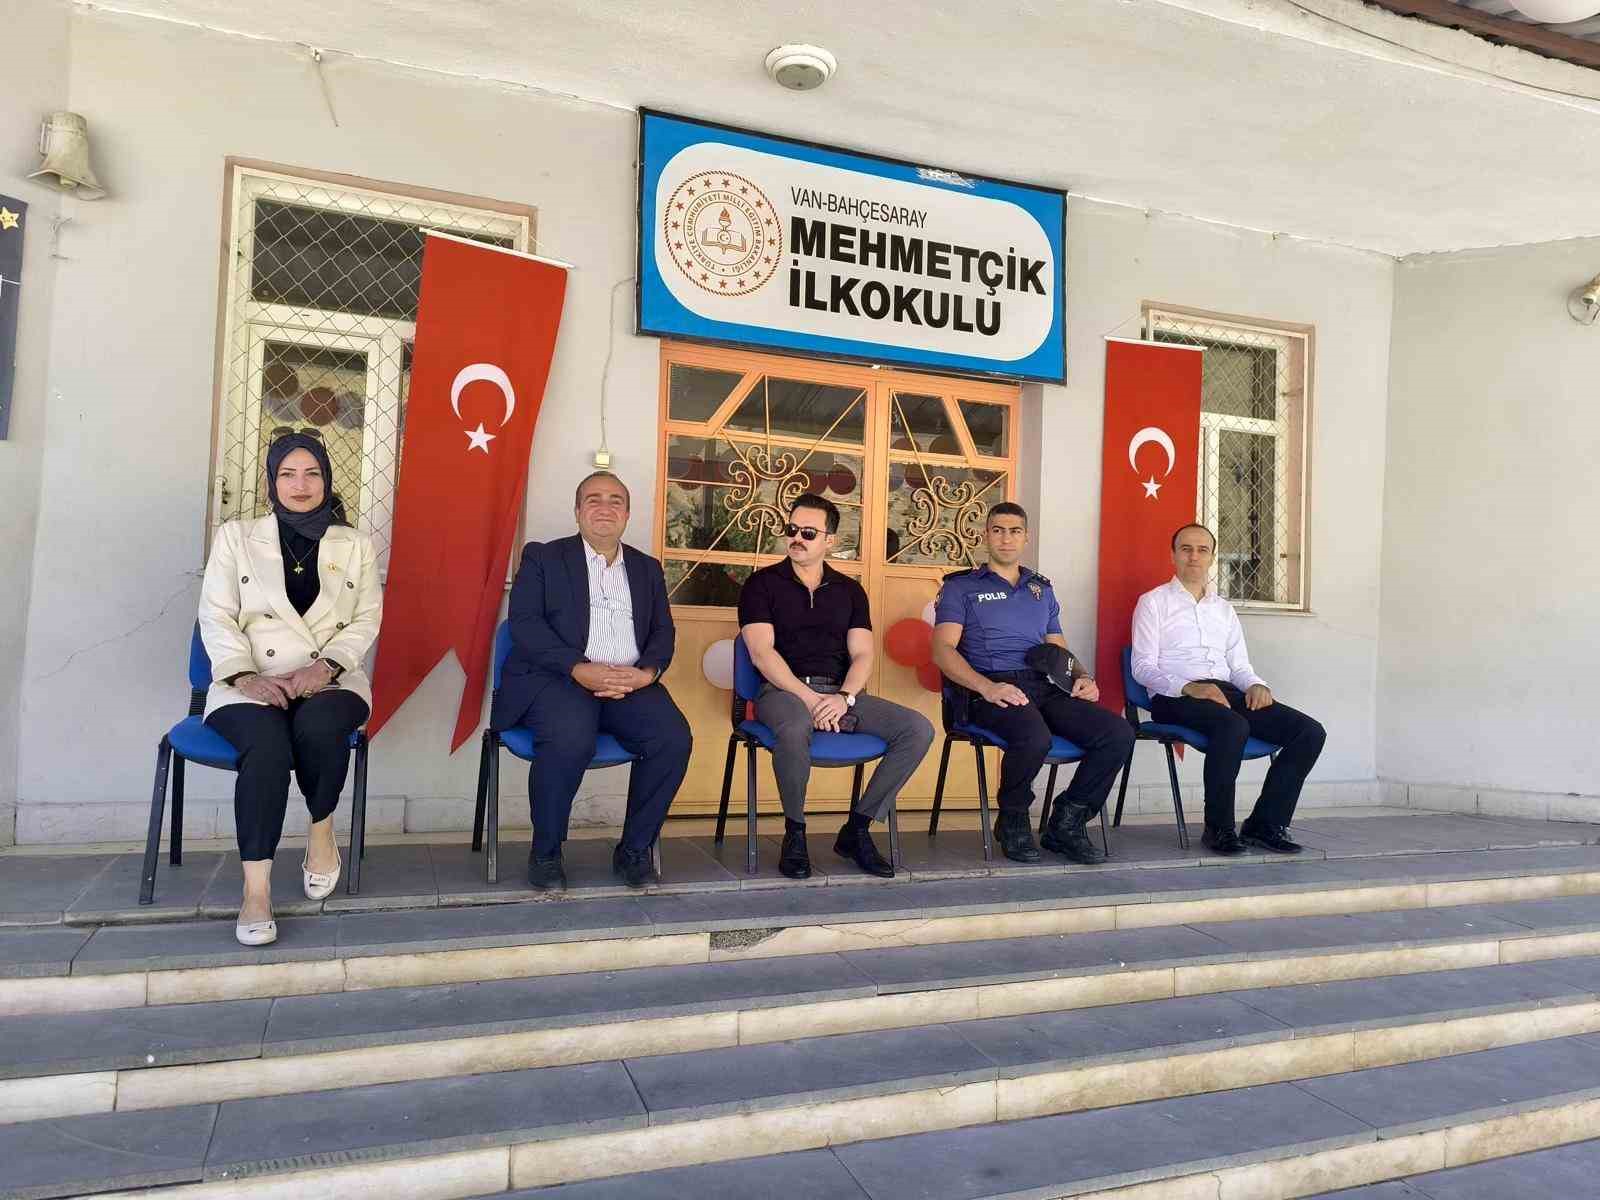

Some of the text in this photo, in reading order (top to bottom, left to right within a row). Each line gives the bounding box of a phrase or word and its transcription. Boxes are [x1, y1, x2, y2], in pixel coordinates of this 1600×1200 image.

[791, 187, 927, 229] VAN-BAHÇESARAY
[790, 216, 1047, 296] MEHMETÇİK
[790, 264, 1001, 336] İLKOKULU
